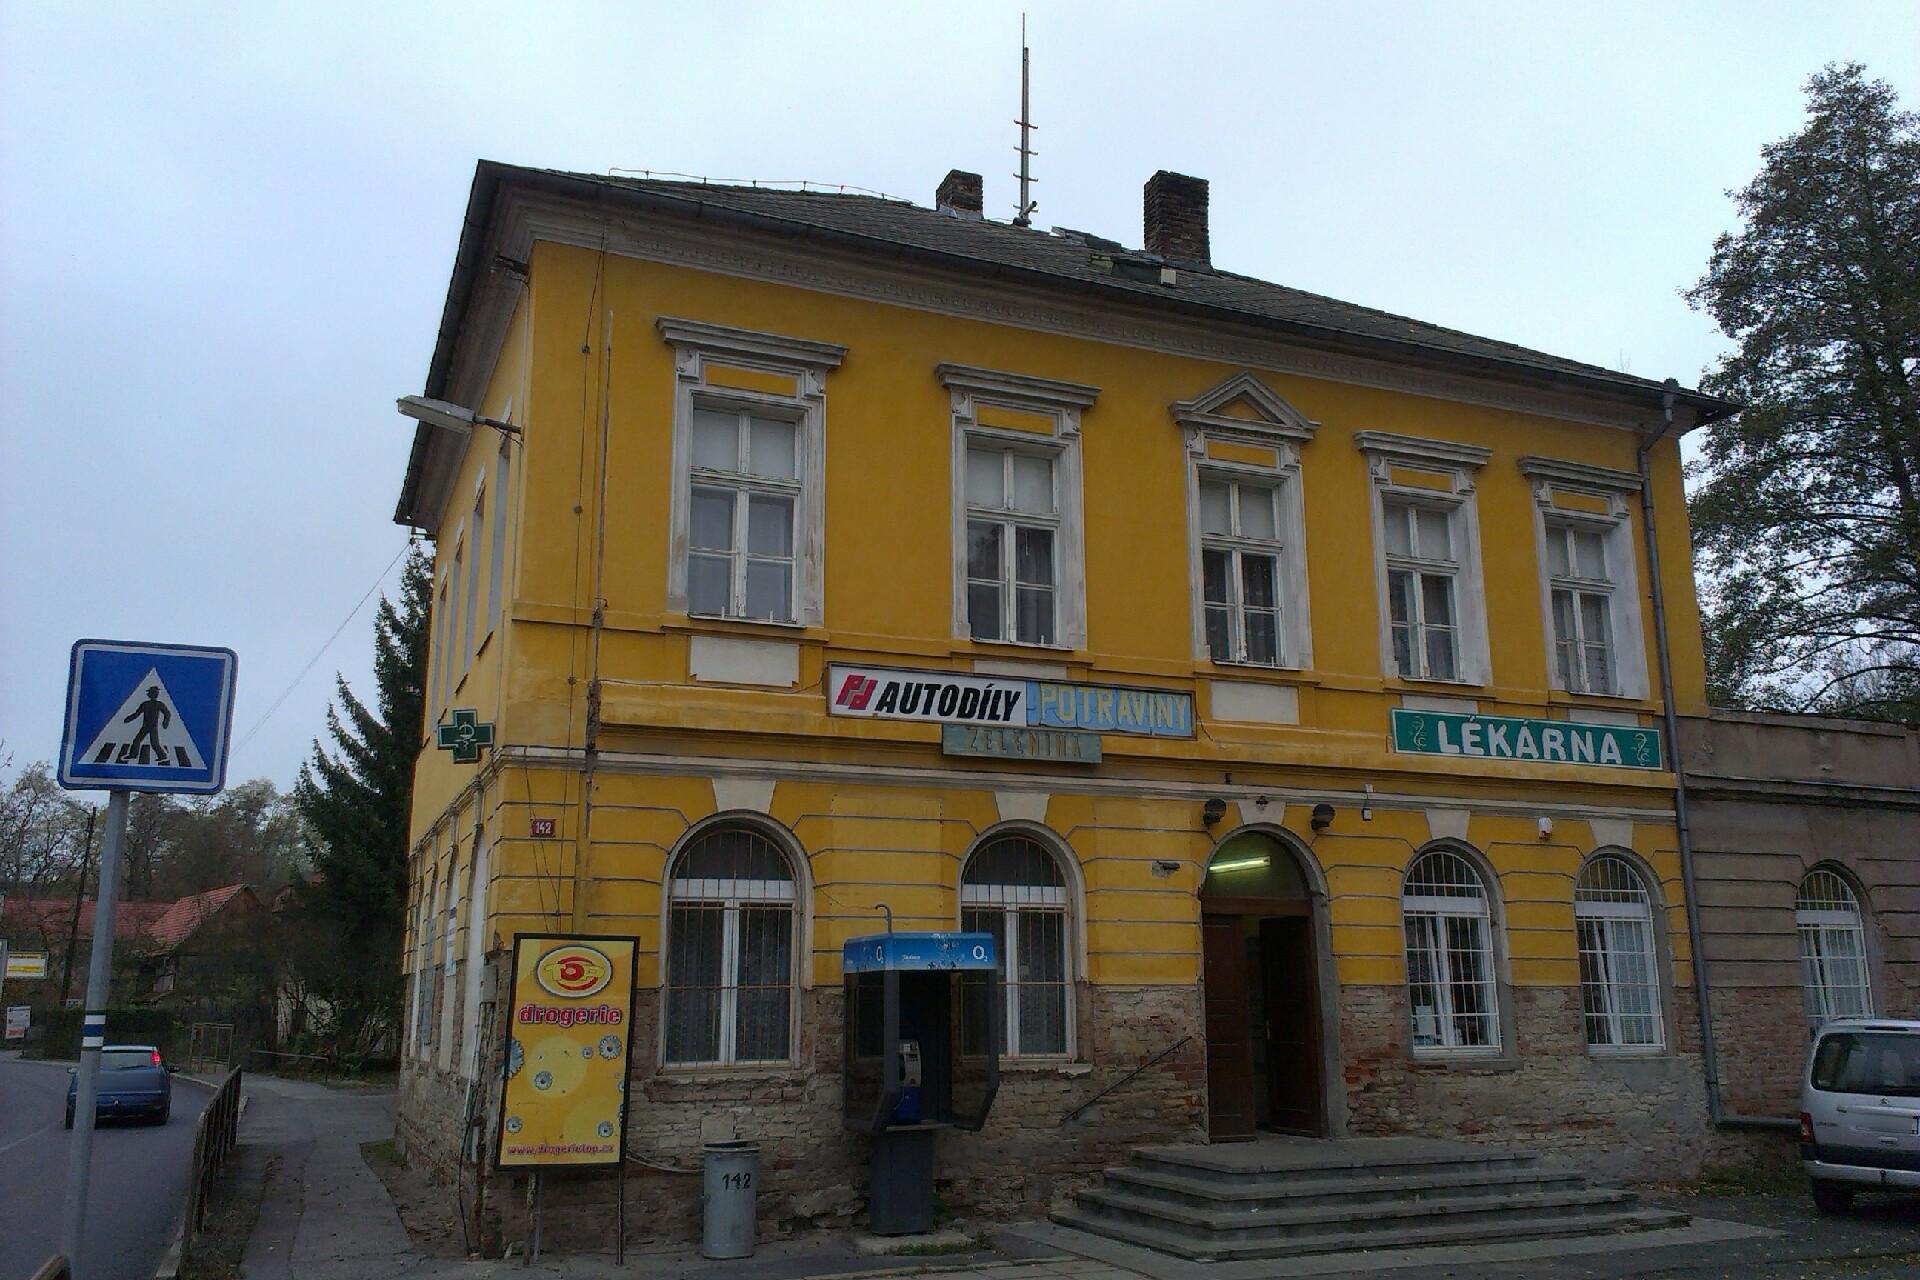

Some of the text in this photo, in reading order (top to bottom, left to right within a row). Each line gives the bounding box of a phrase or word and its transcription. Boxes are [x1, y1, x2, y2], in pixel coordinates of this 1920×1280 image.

[875, 682, 1021, 722] AUTODÍLY
[1038, 682, 1190, 731] POTRAVINY
[966, 726, 1082, 759] ZELENINA
[1437, 715, 1623, 765] LÉKÁRNA
[535, 821, 552, 834] 142
[519, 1003, 623, 1028] drogerie
[722, 1172, 752, 1191] 142
